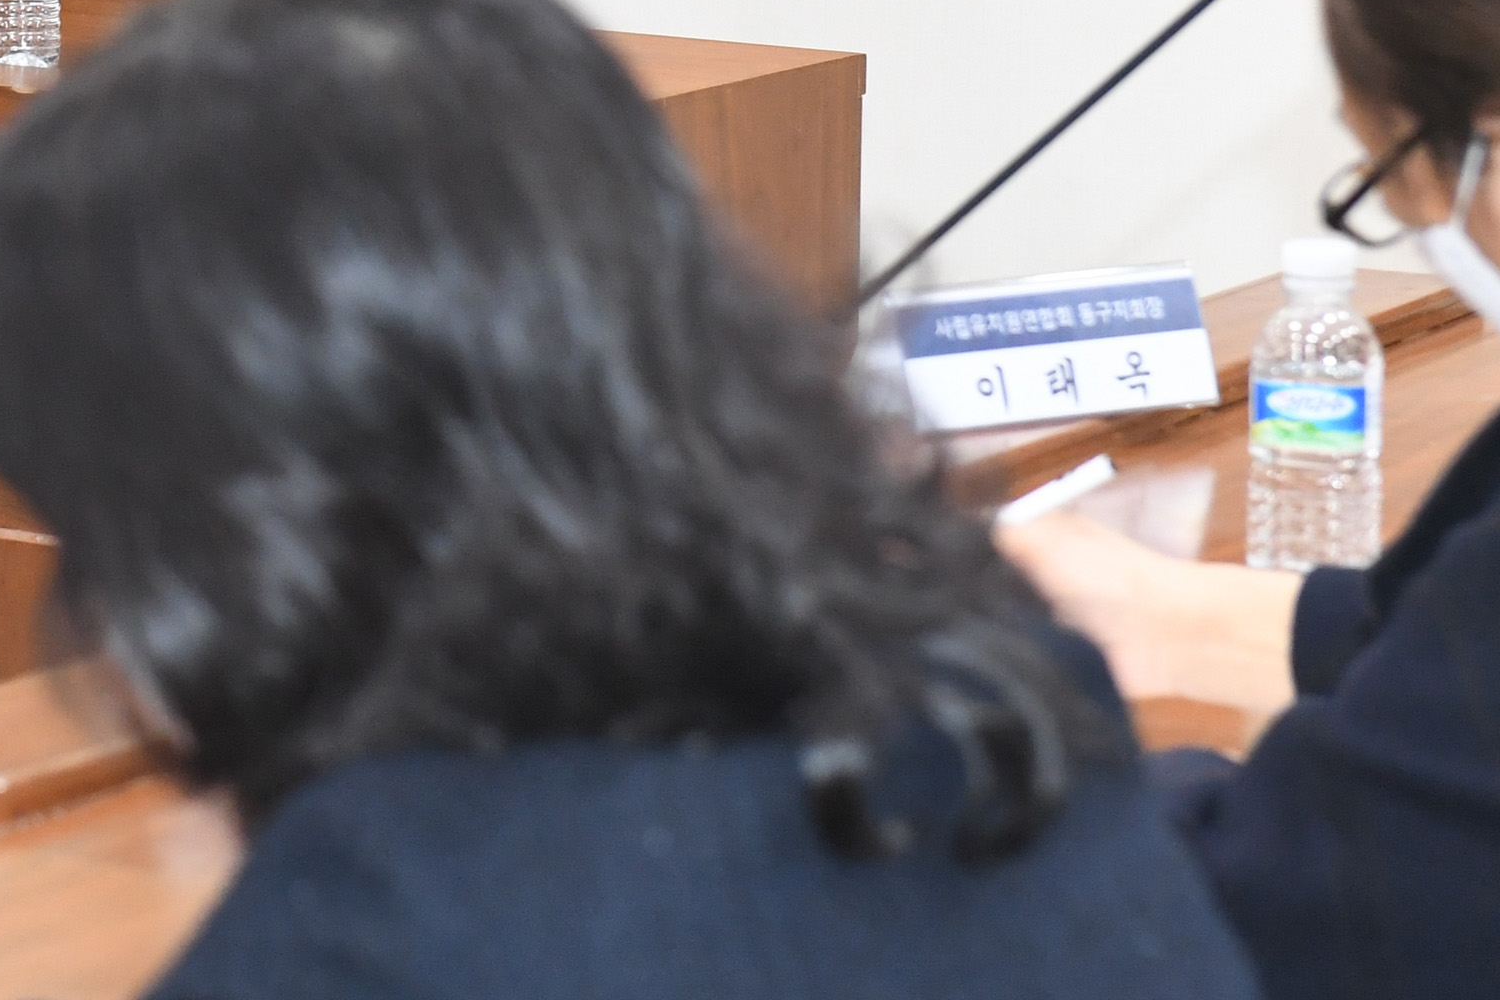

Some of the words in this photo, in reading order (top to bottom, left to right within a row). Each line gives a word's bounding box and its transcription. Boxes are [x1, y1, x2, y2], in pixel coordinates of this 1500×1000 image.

[977, 364, 1008, 414] 이
[1046, 357, 1079, 406] 태
[1116, 351, 1151, 399] 옥
